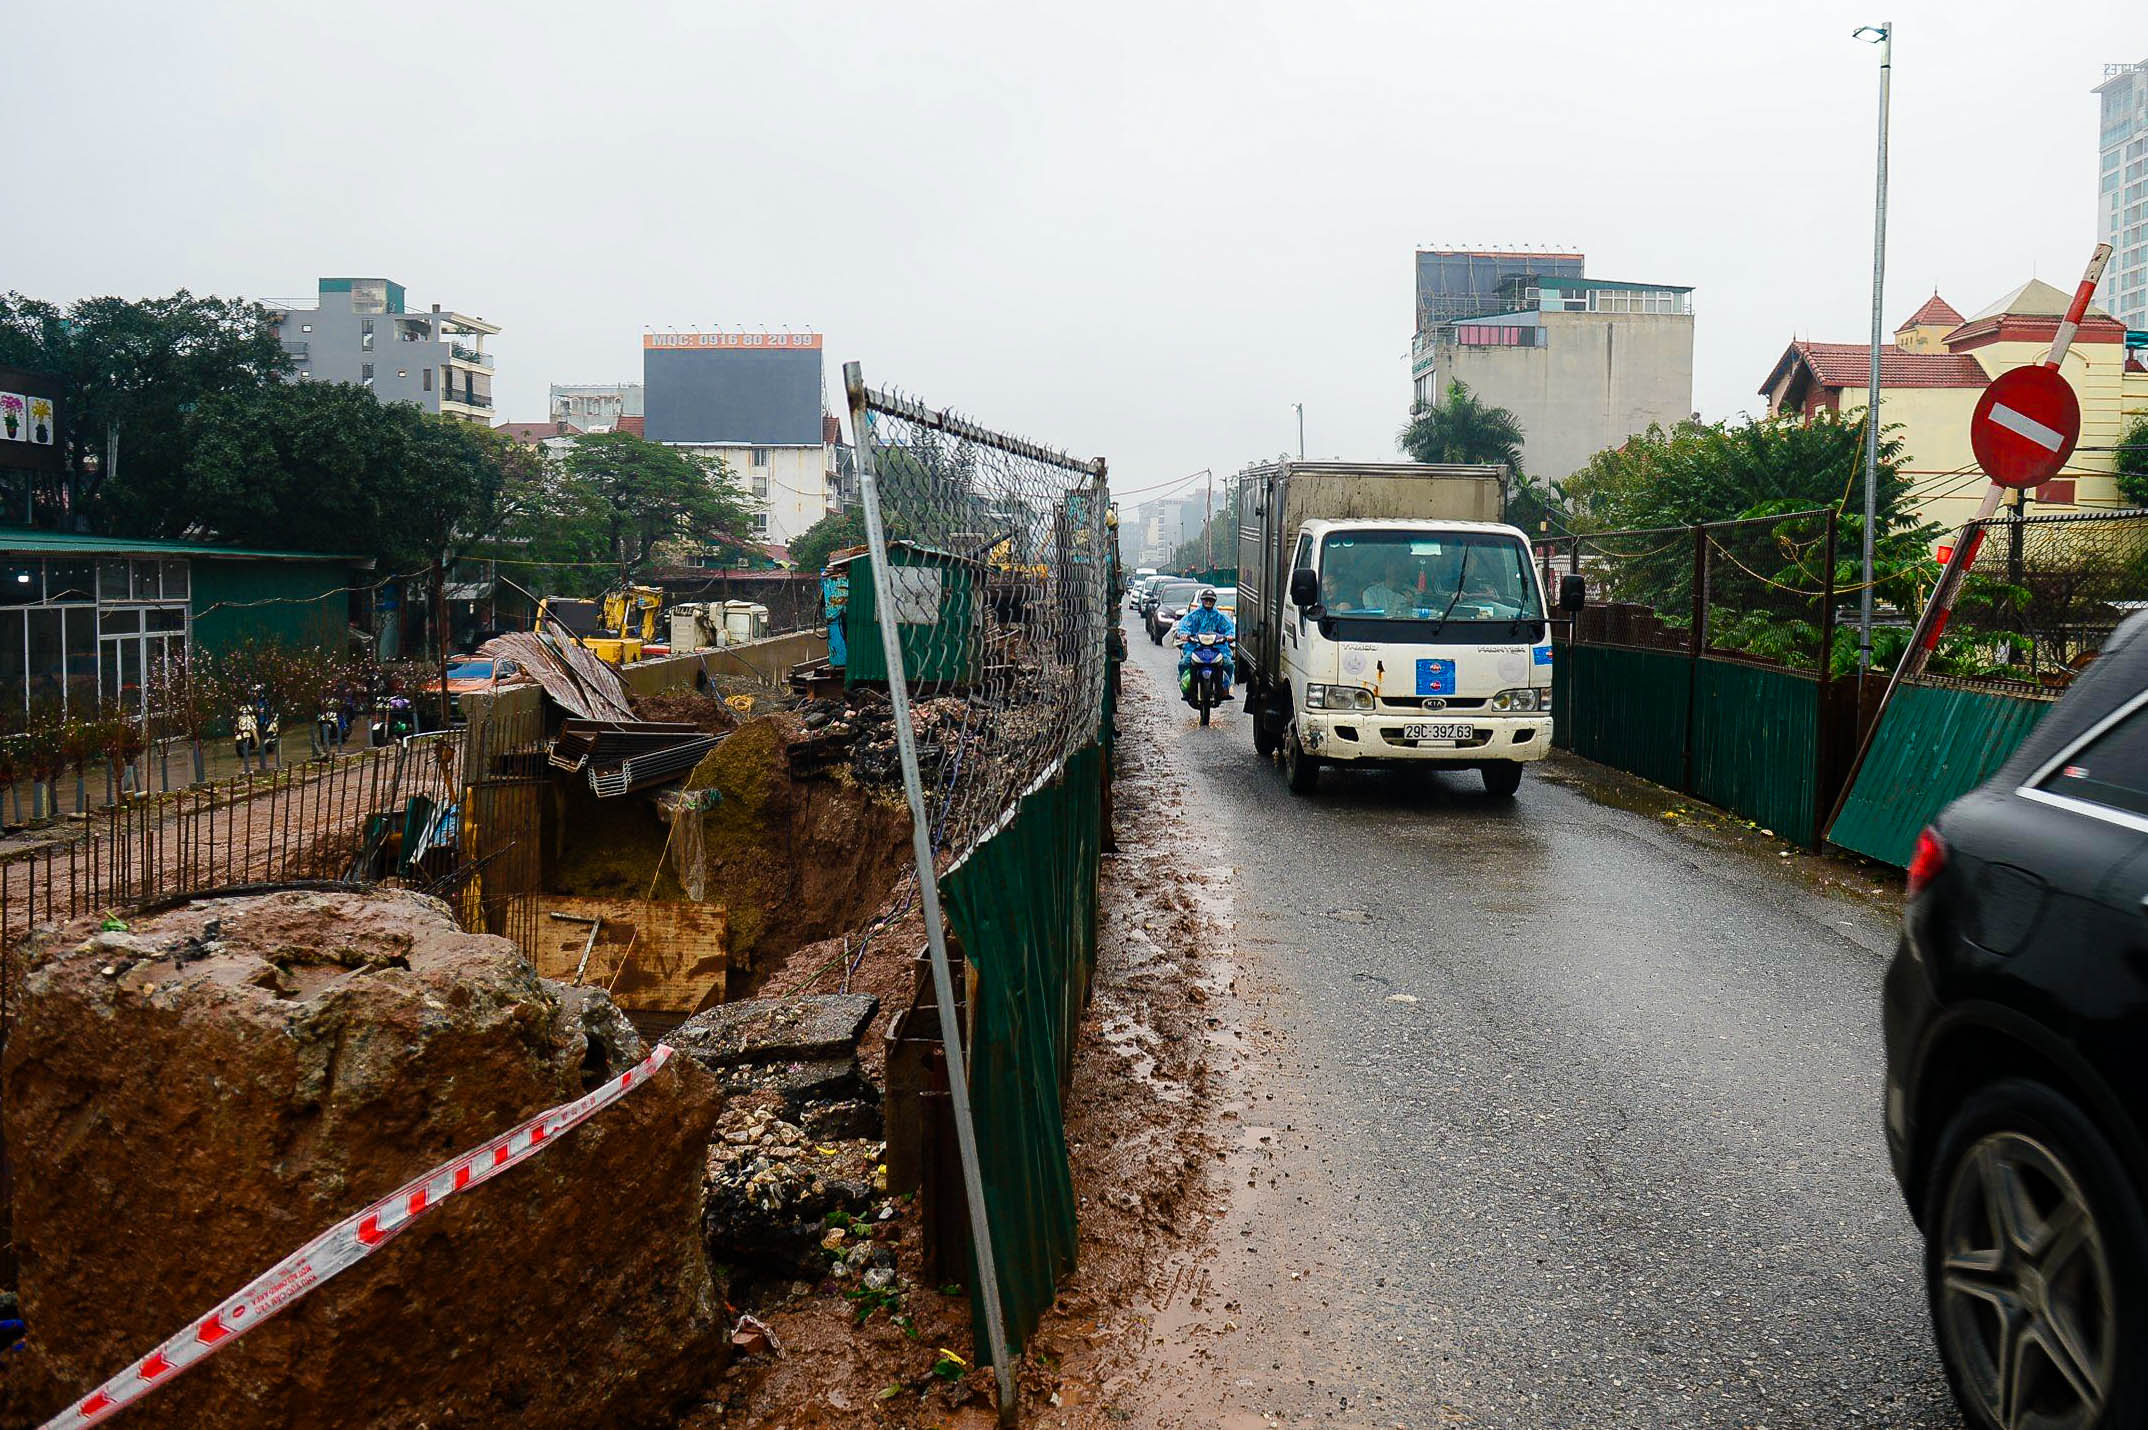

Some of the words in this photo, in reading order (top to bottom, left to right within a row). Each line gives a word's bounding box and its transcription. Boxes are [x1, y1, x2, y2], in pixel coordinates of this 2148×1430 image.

[653, 334, 693, 347] MQC:
[699, 334, 738, 346] 0916
[743, 334, 763, 346] 80
[767, 334, 787, 346] 20
[792, 334, 813, 346] 99
